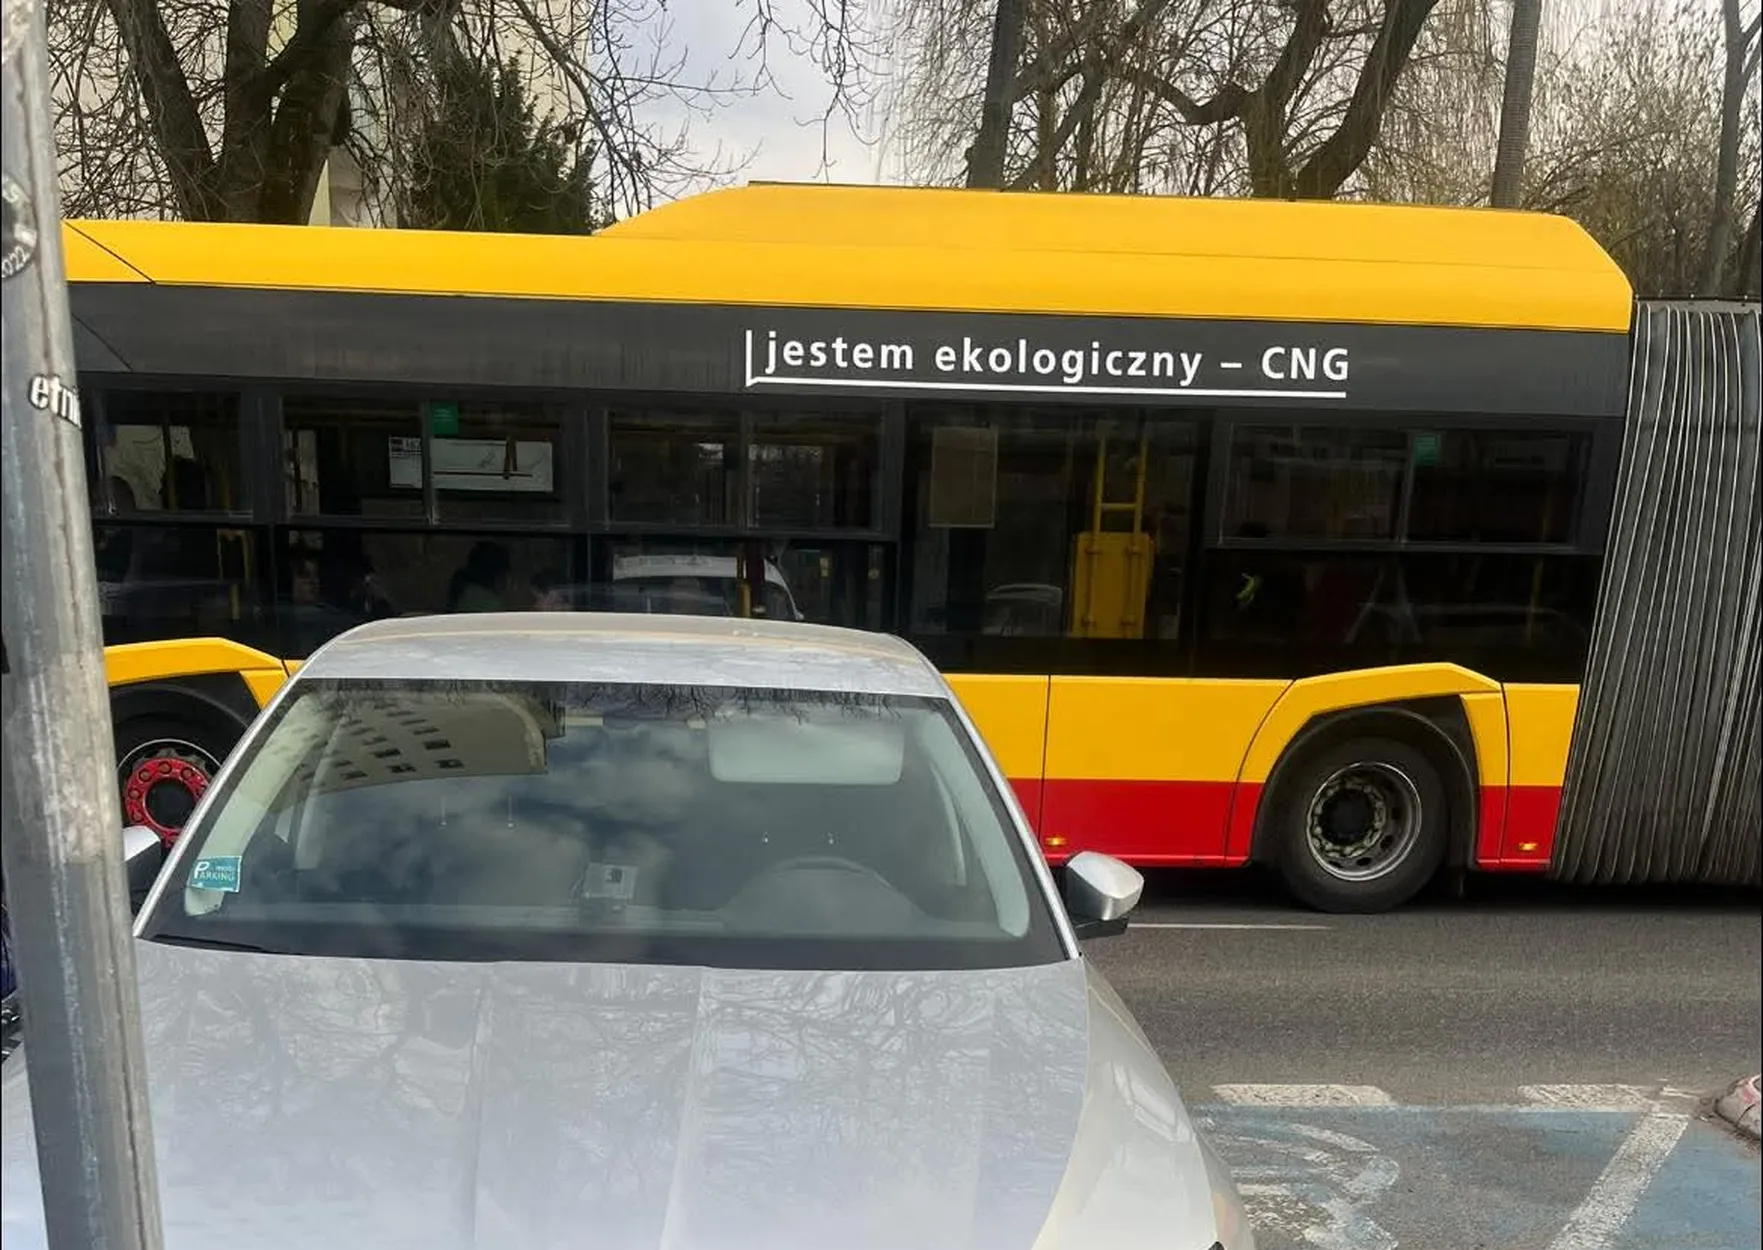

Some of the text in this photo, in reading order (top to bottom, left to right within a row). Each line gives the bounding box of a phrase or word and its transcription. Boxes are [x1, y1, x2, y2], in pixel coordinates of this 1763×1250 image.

[765, 330, 914, 374] jestem
[934, 337, 1203, 386] ekologiczny
[1261, 346, 1350, 381] CNG
